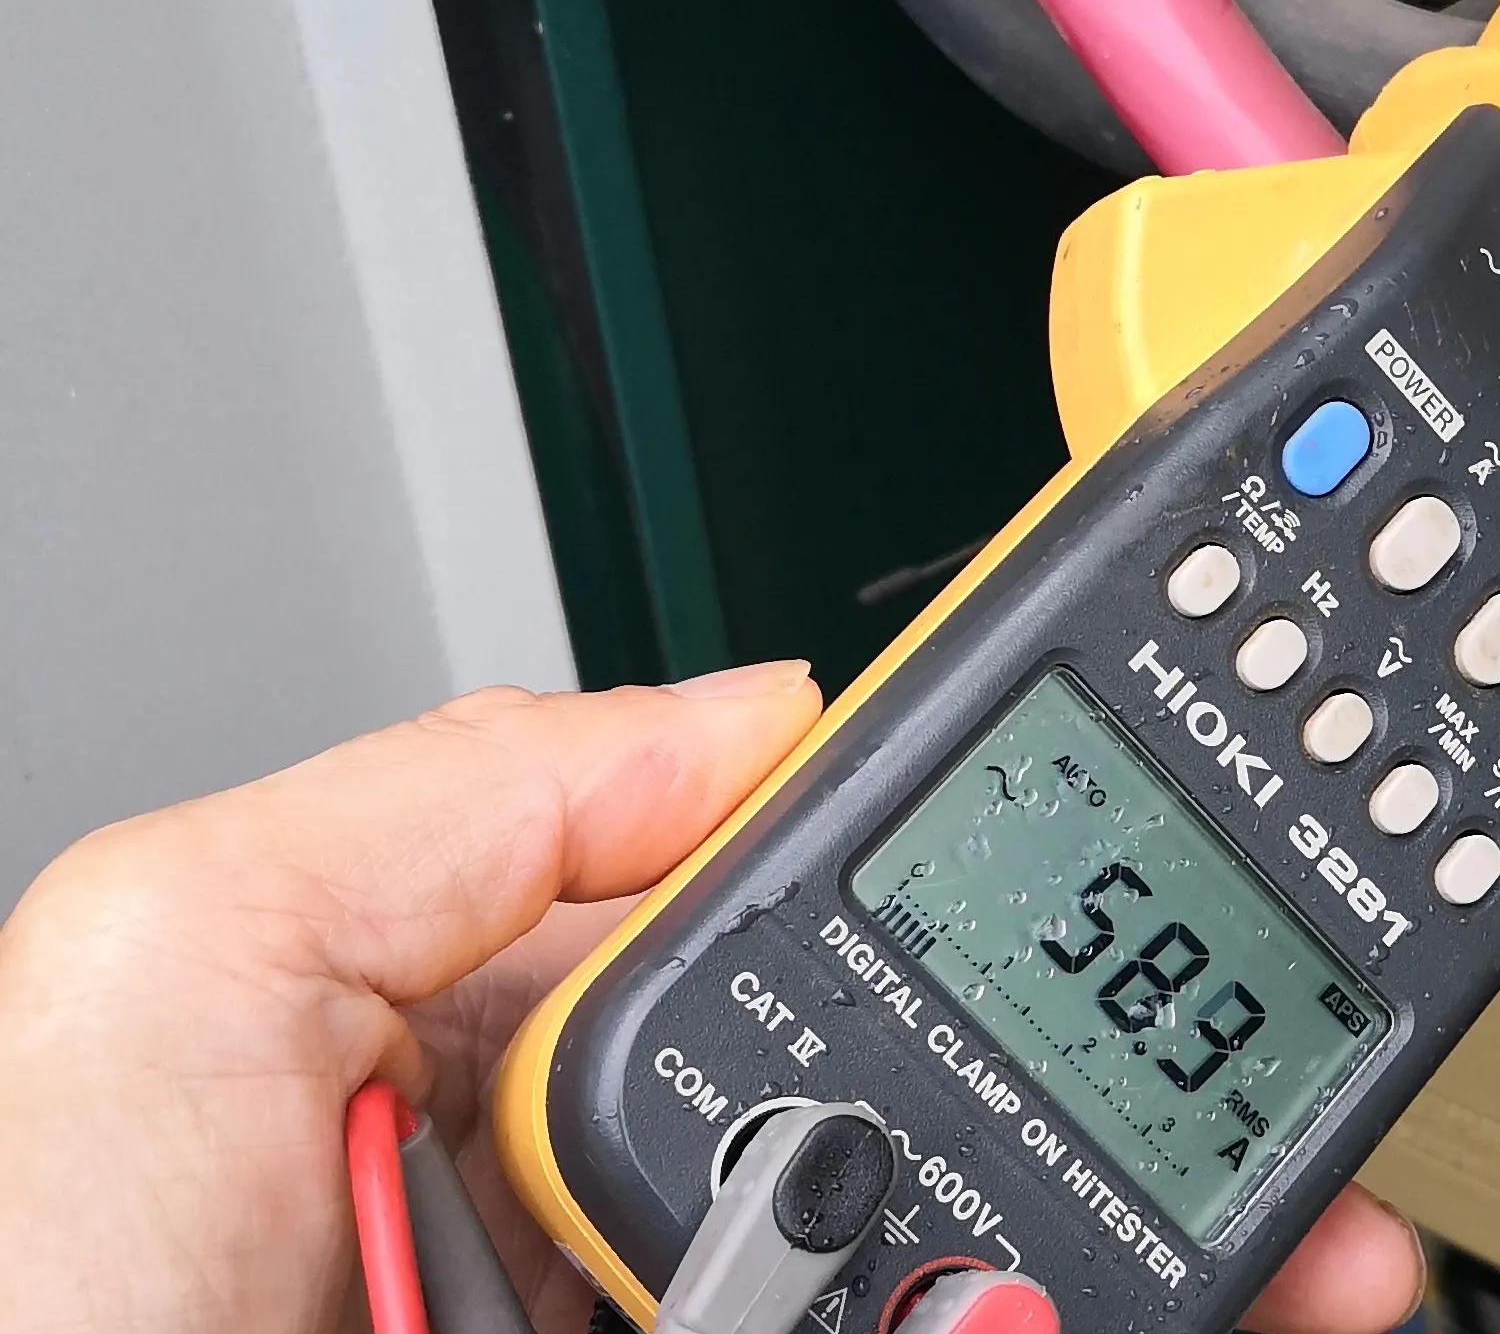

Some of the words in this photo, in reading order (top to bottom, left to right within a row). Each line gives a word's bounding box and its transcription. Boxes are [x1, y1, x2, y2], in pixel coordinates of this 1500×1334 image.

[1374, 339, 1455, 432] POWER
[1301, 570, 1339, 618] Hz
[1435, 693, 1479, 744] MAX
[1127, 639, 1286, 807] HIOKI
[1288, 814, 1411, 950] 3281
[729, 971, 795, 1036] CAT
[1323, 990, 1366, 1034] APS
[653, 1046, 728, 1123] COM
[817, 915, 923, 1029] DIGITAL
[926, 1024, 1022, 1115] CLAMP
[1020, 1118, 1067, 1167] ON
[1063, 1164, 1188, 1290] HiTESTER
[1224, 1089, 1270, 1138] RMS
[1217, 1137, 1250, 1173] A
